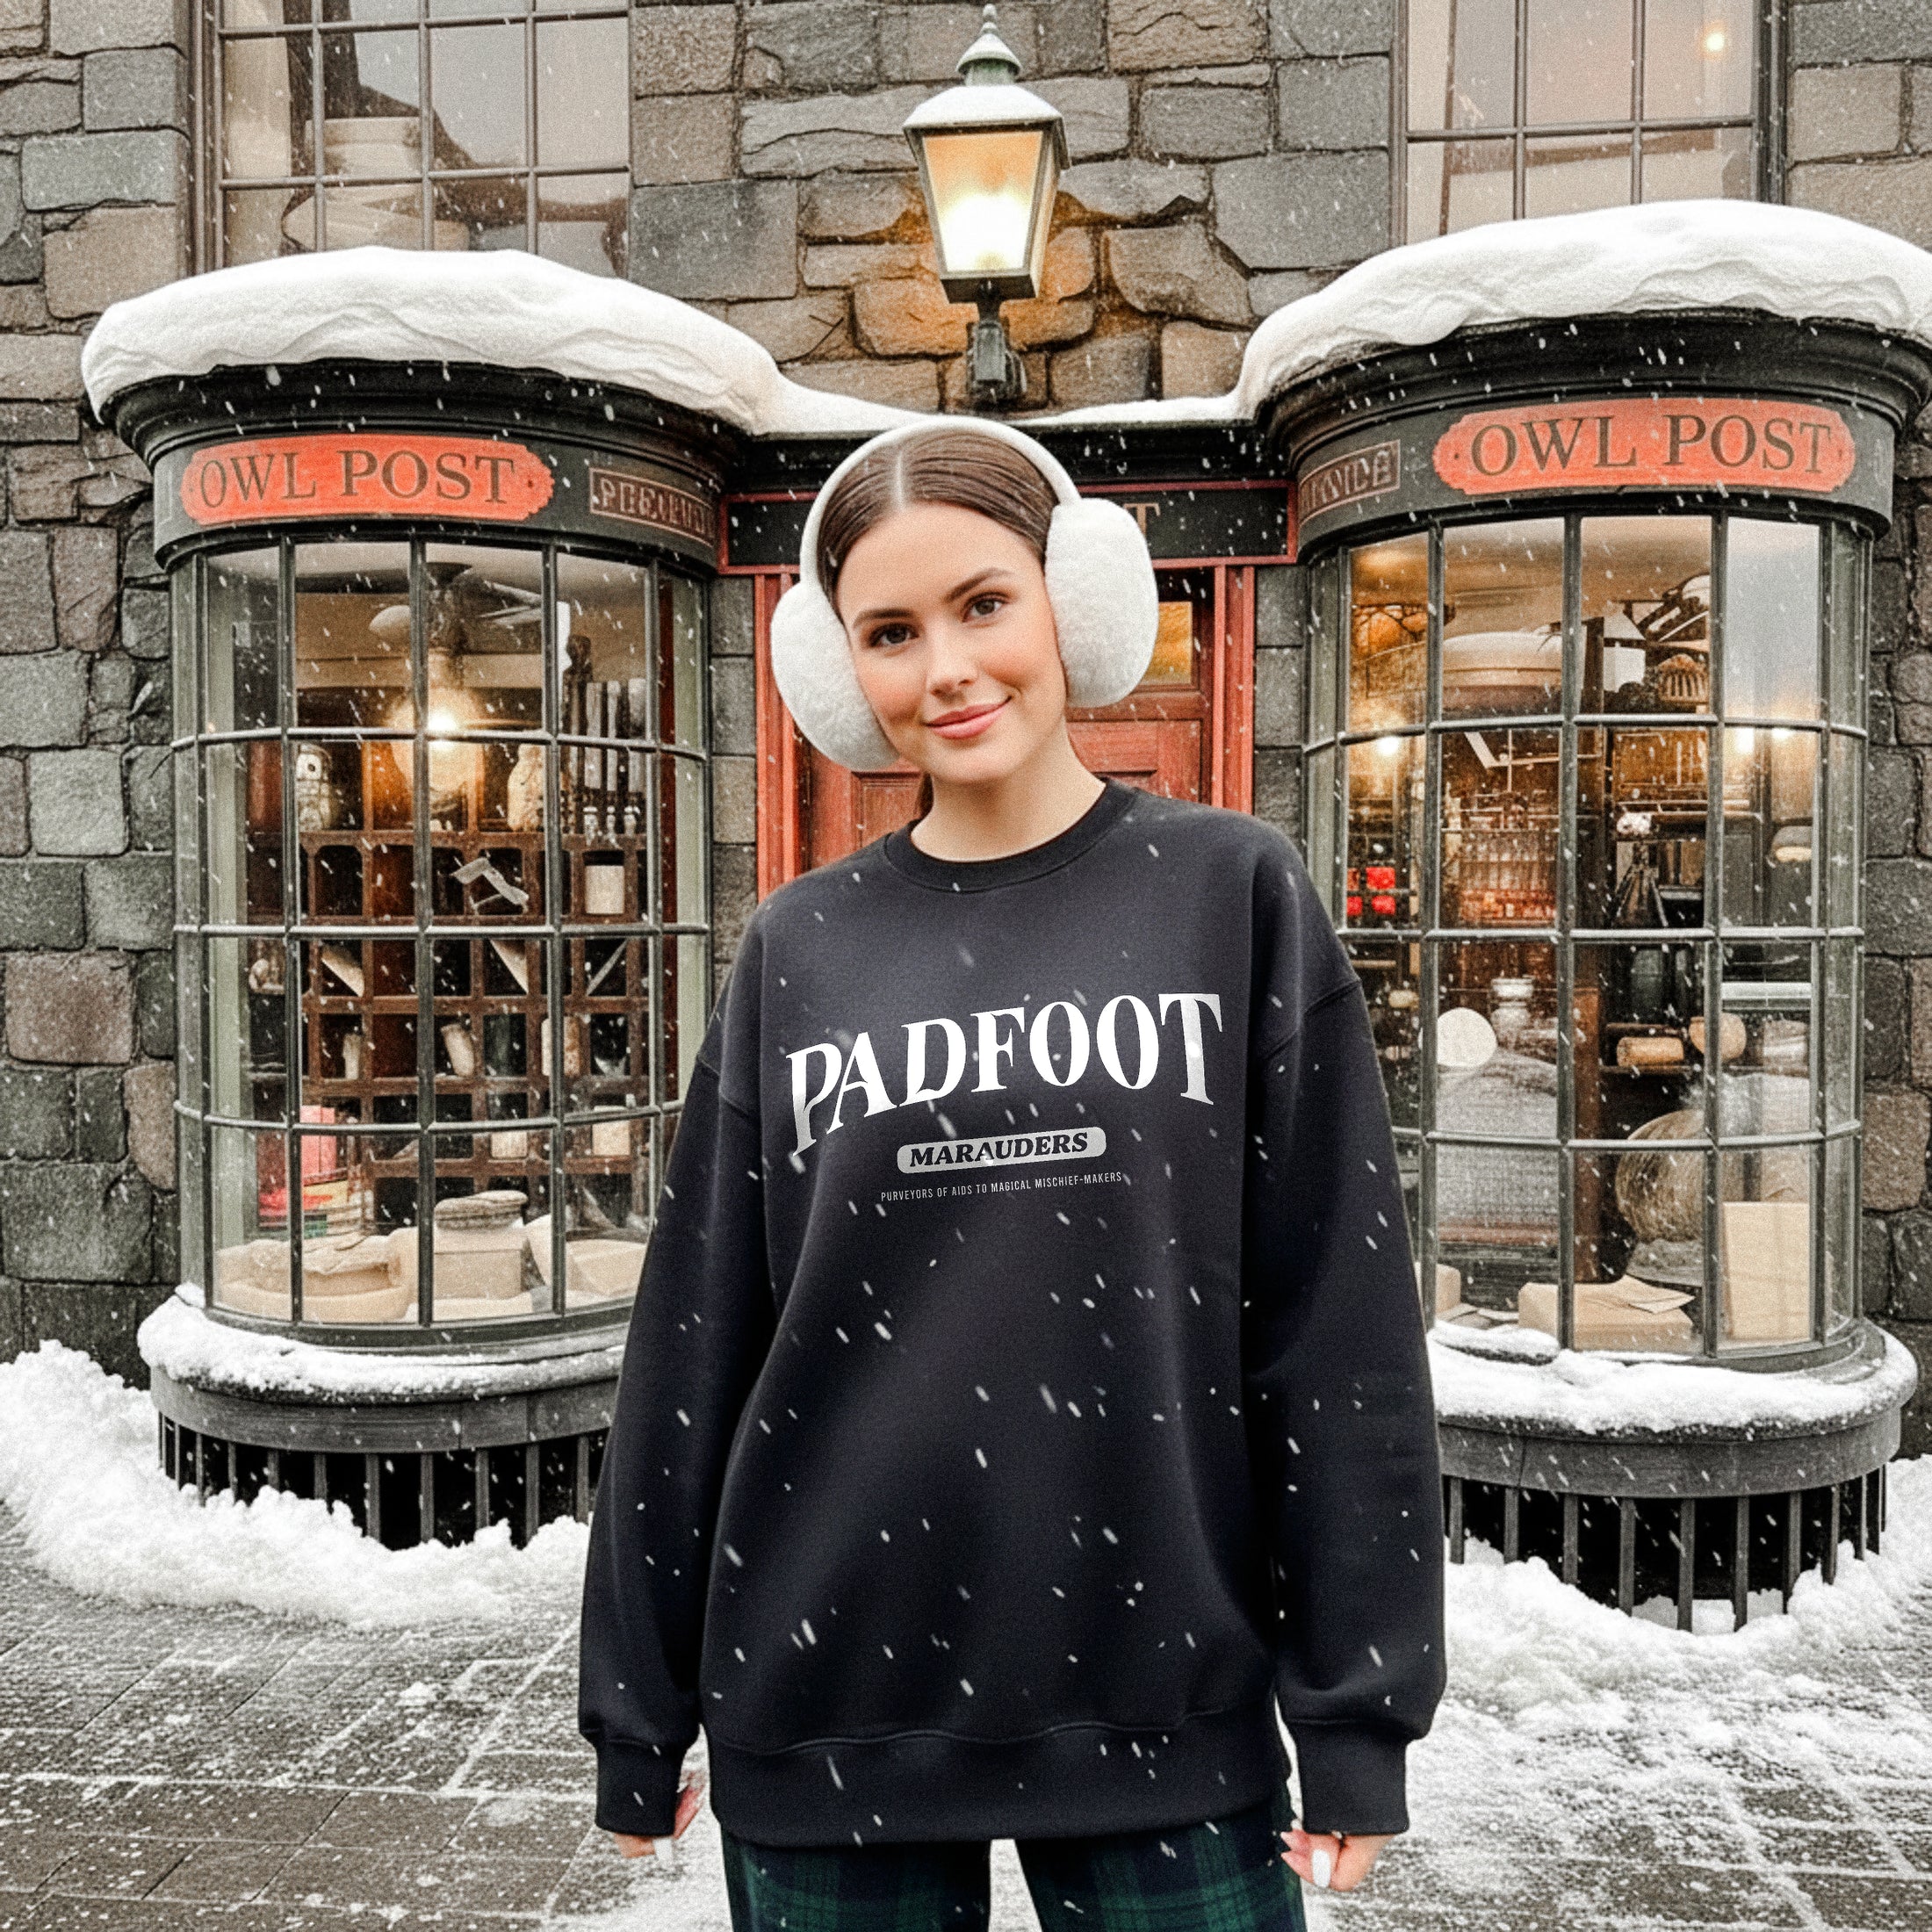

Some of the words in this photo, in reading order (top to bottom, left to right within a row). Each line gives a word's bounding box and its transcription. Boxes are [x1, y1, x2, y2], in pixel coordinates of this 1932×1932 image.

[1471, 415, 1637, 476] OWL
[1662, 413, 1832, 474] POST
[200, 452, 316, 508] OWL
[336, 450, 515, 503] POST
[786, 993, 1223, 1157] PADFOOT
[910, 1133, 1088, 1168] MARAUDERS
[881, 1188, 933, 1201] PURVEYORS
[937, 1186, 948, 1198] OF
[951, 1185, 972, 1196] AIDS
[977, 1183, 987, 1194] TO
[991, 1179, 1031, 1193] MAGICAL
[1034, 1171, 1122, 1188] MISCHIEF-MAKERS
